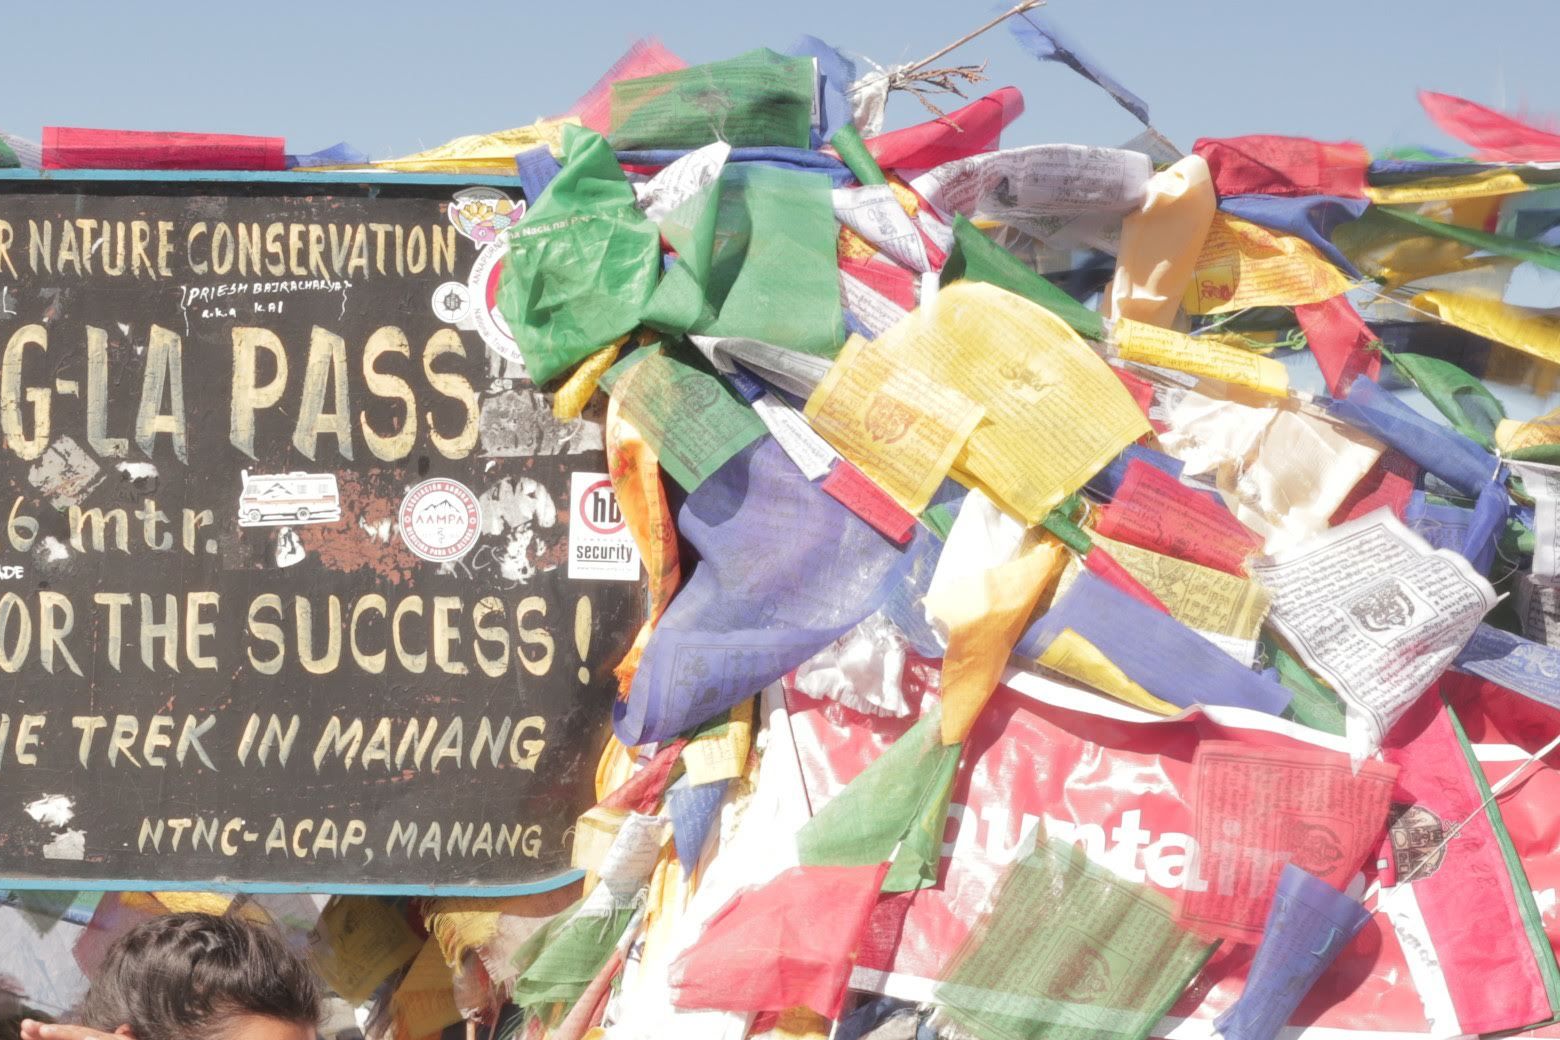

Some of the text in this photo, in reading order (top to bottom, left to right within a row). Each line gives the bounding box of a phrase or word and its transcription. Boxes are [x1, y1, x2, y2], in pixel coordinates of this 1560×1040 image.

[28, 218, 174, 277] NATURE
[187, 221, 458, 279] CONSERVATION
[188, 283, 249, 305] PRIESH
[229, 325, 480, 463] PASS
[68, 498, 218, 555] mtr.
[416, 514, 465, 525] AAMPA
[576, 544, 633, 563] security
[94, 592, 220, 673] THE
[247, 593, 554, 677] SUCCESS
[72, 713, 217, 770] TREK
[236, 713, 300, 768] IN
[313, 715, 547, 773] MANANG
[137, 816, 543, 866] NTNC-ACAP, MANANG
